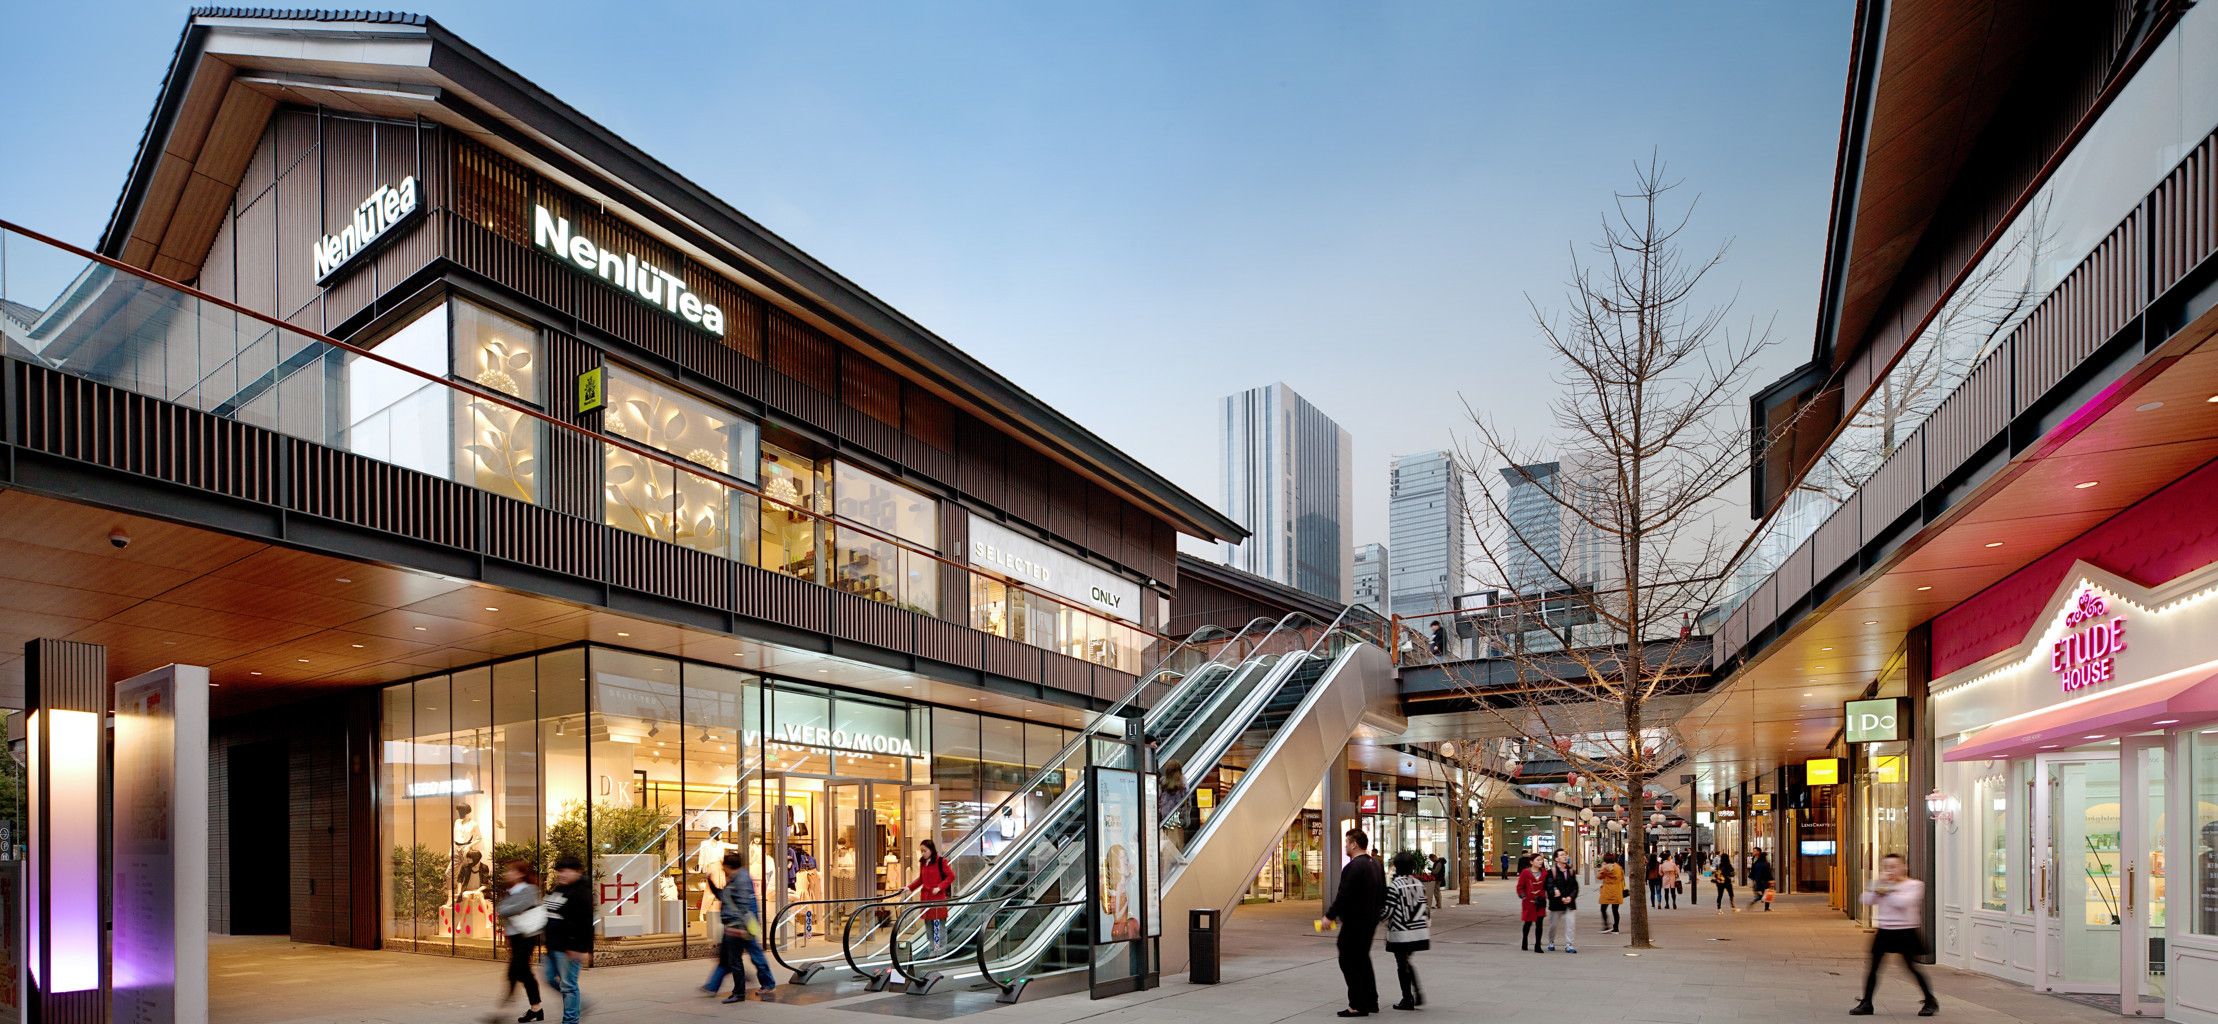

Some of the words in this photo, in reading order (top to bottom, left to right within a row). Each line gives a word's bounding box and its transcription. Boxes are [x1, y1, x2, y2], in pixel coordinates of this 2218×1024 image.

[313, 175, 416, 282] NenlüTea
[535, 204, 724, 336] NenlüTea
[975, 542, 1050, 583] SELECTED
[1091, 587, 1121, 609] ONLY
[2051, 615, 2127, 673] ETUDE
[2062, 658, 2114, 692] HOUSE
[784, 723, 848, 750] VERO
[851, 732, 914, 757] MODA
[600, 873, 640, 916] 中
